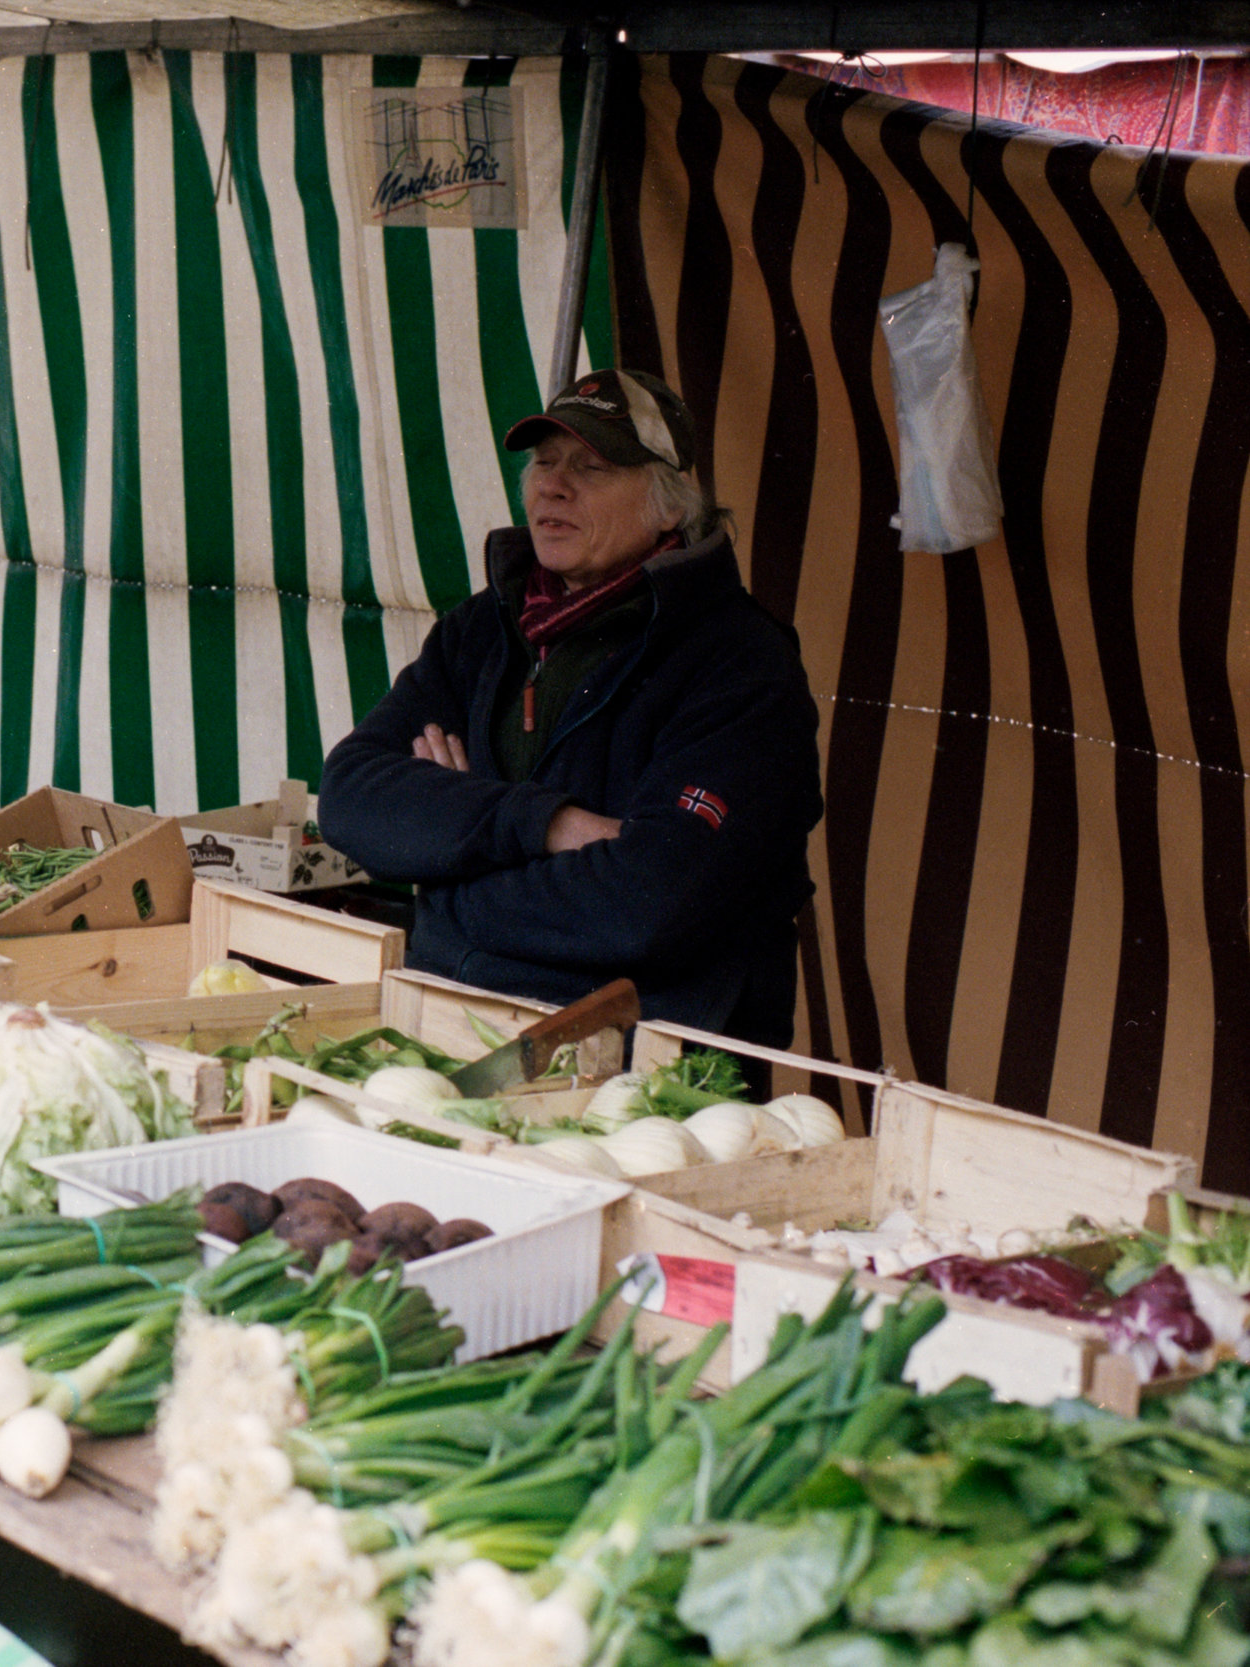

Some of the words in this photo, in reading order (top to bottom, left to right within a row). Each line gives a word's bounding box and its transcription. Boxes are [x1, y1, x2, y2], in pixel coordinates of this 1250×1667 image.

[372, 157, 442, 216] Marchés
[461, 145, 500, 183] Paris
[189, 848, 231, 863] Passion
